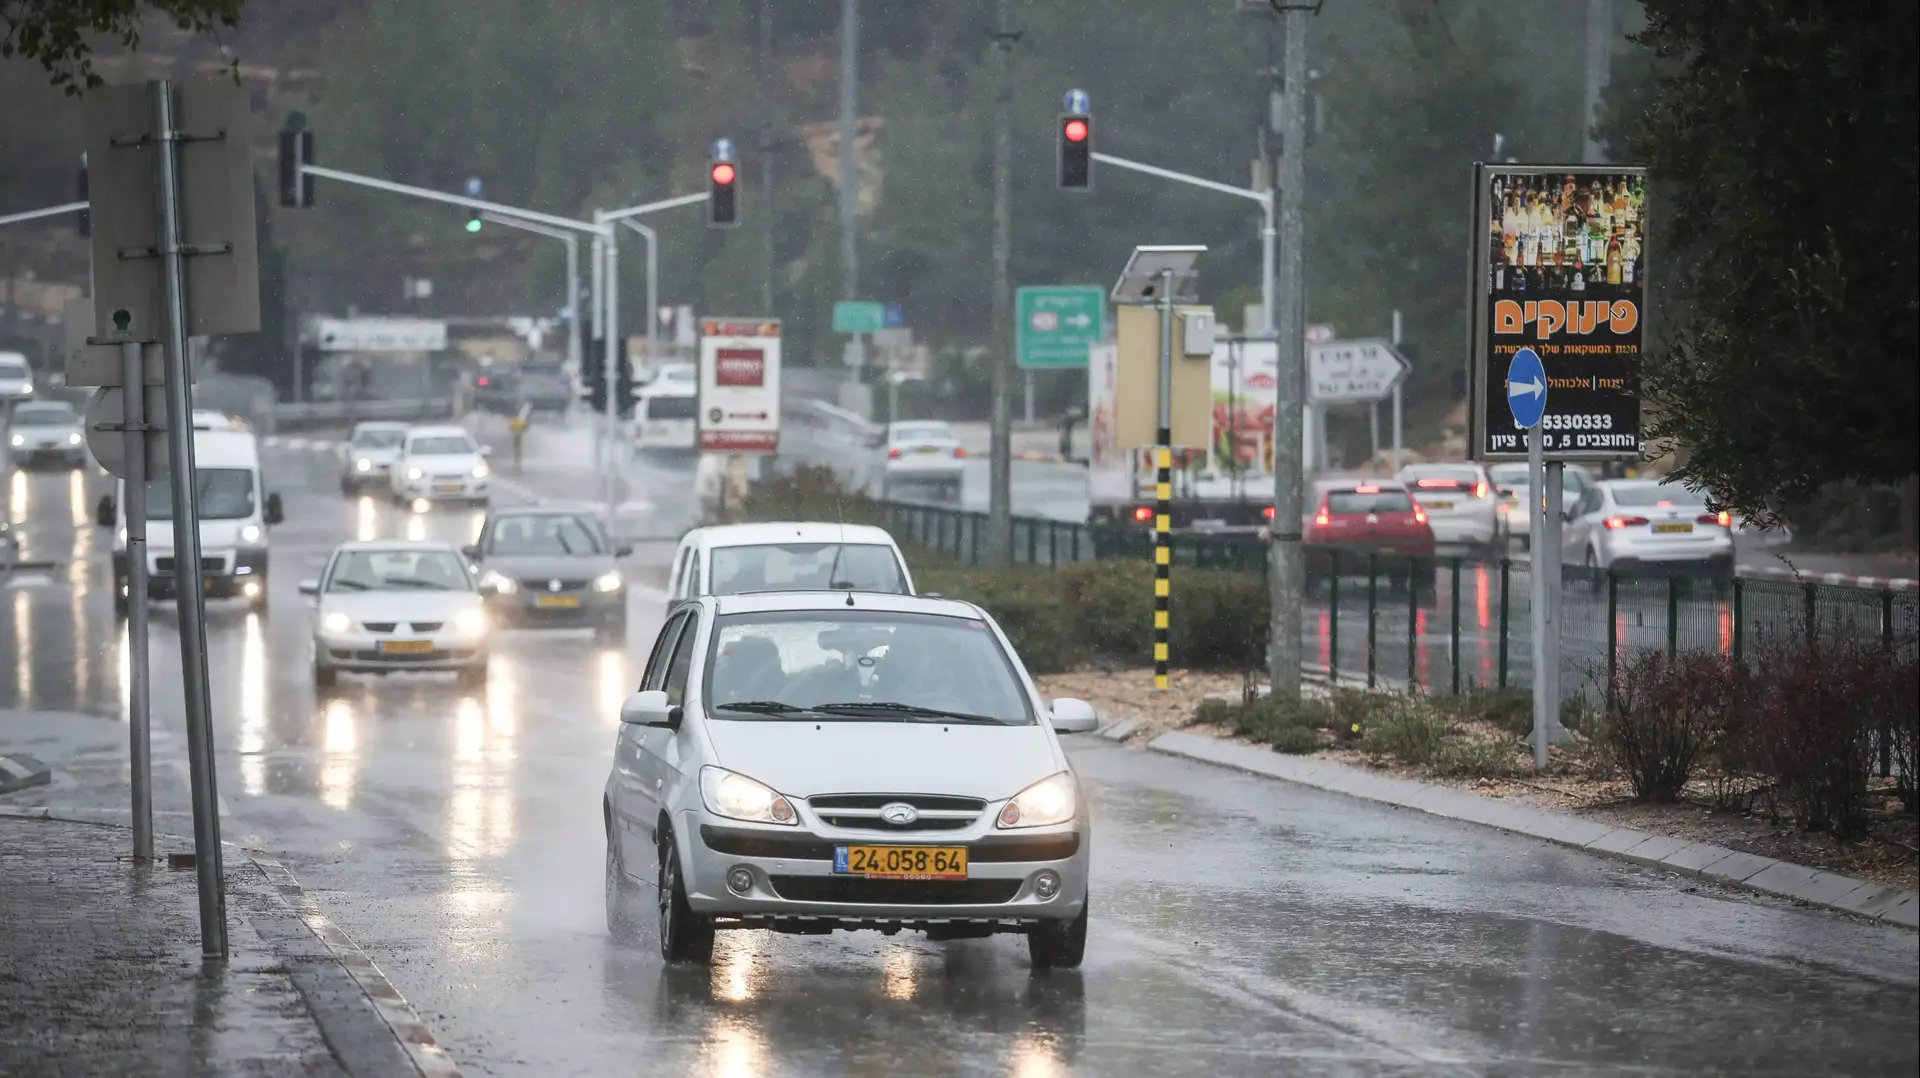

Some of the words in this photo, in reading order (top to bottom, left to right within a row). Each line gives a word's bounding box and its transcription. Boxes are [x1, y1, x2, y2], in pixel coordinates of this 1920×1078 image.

[1494, 299, 1638, 340] פינוקים
[1494, 344, 1535, 354] שרת
[1539, 343, 1560, 356] שלך
[1563, 344, 1611, 356] המשקאות
[1548, 376, 1590, 389] אלכוהול
[1514, 414, 1612, 430] 5330333
[1491, 434, 1517, 451] ציון
[1577, 434, 1635, 447] החוצבים
